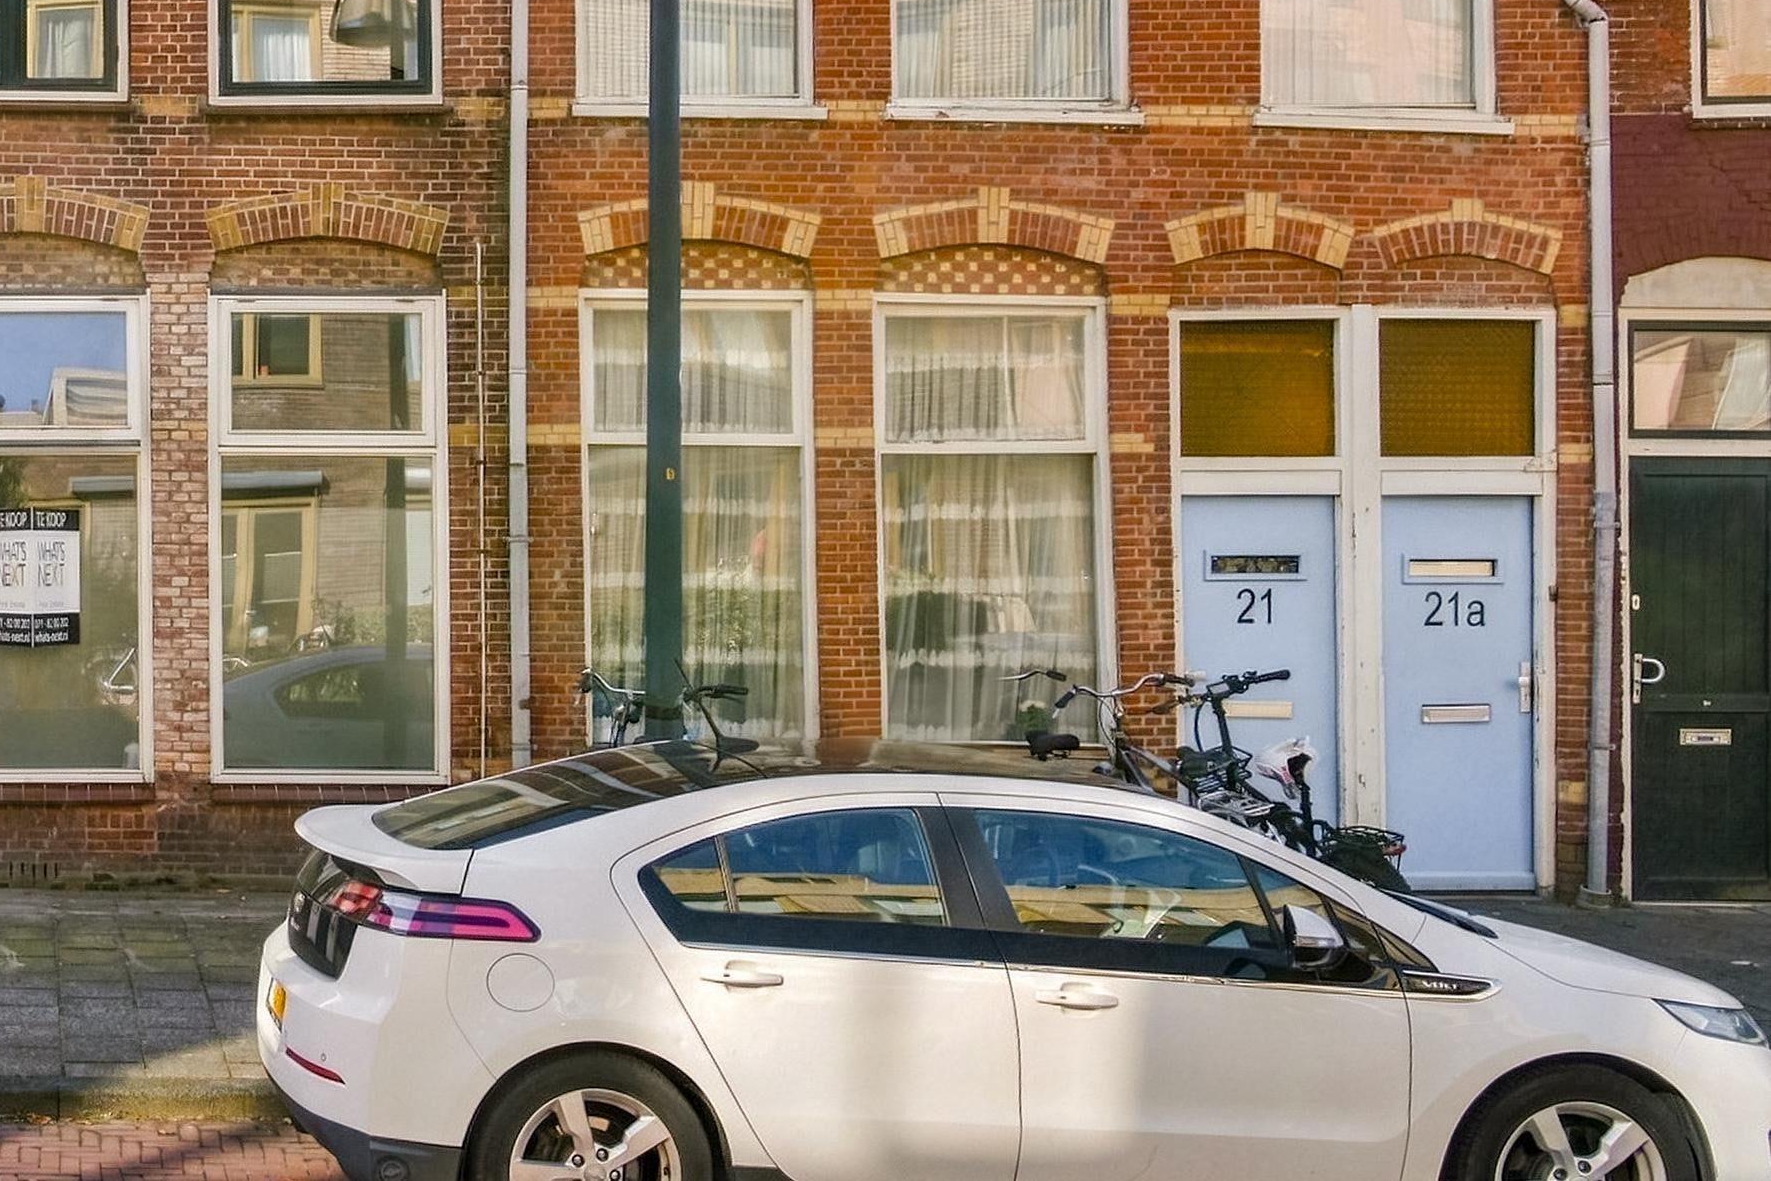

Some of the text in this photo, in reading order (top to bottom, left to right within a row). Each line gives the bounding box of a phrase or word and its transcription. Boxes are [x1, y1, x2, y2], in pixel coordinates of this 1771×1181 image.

[5, 511, 28, 528] KOOP
[36, 511, 67, 528] TE KOOP
[37, 563, 65, 587] NEXT
[1236, 587, 1273, 625] 21
[1423, 591, 1486, 627] 21a
